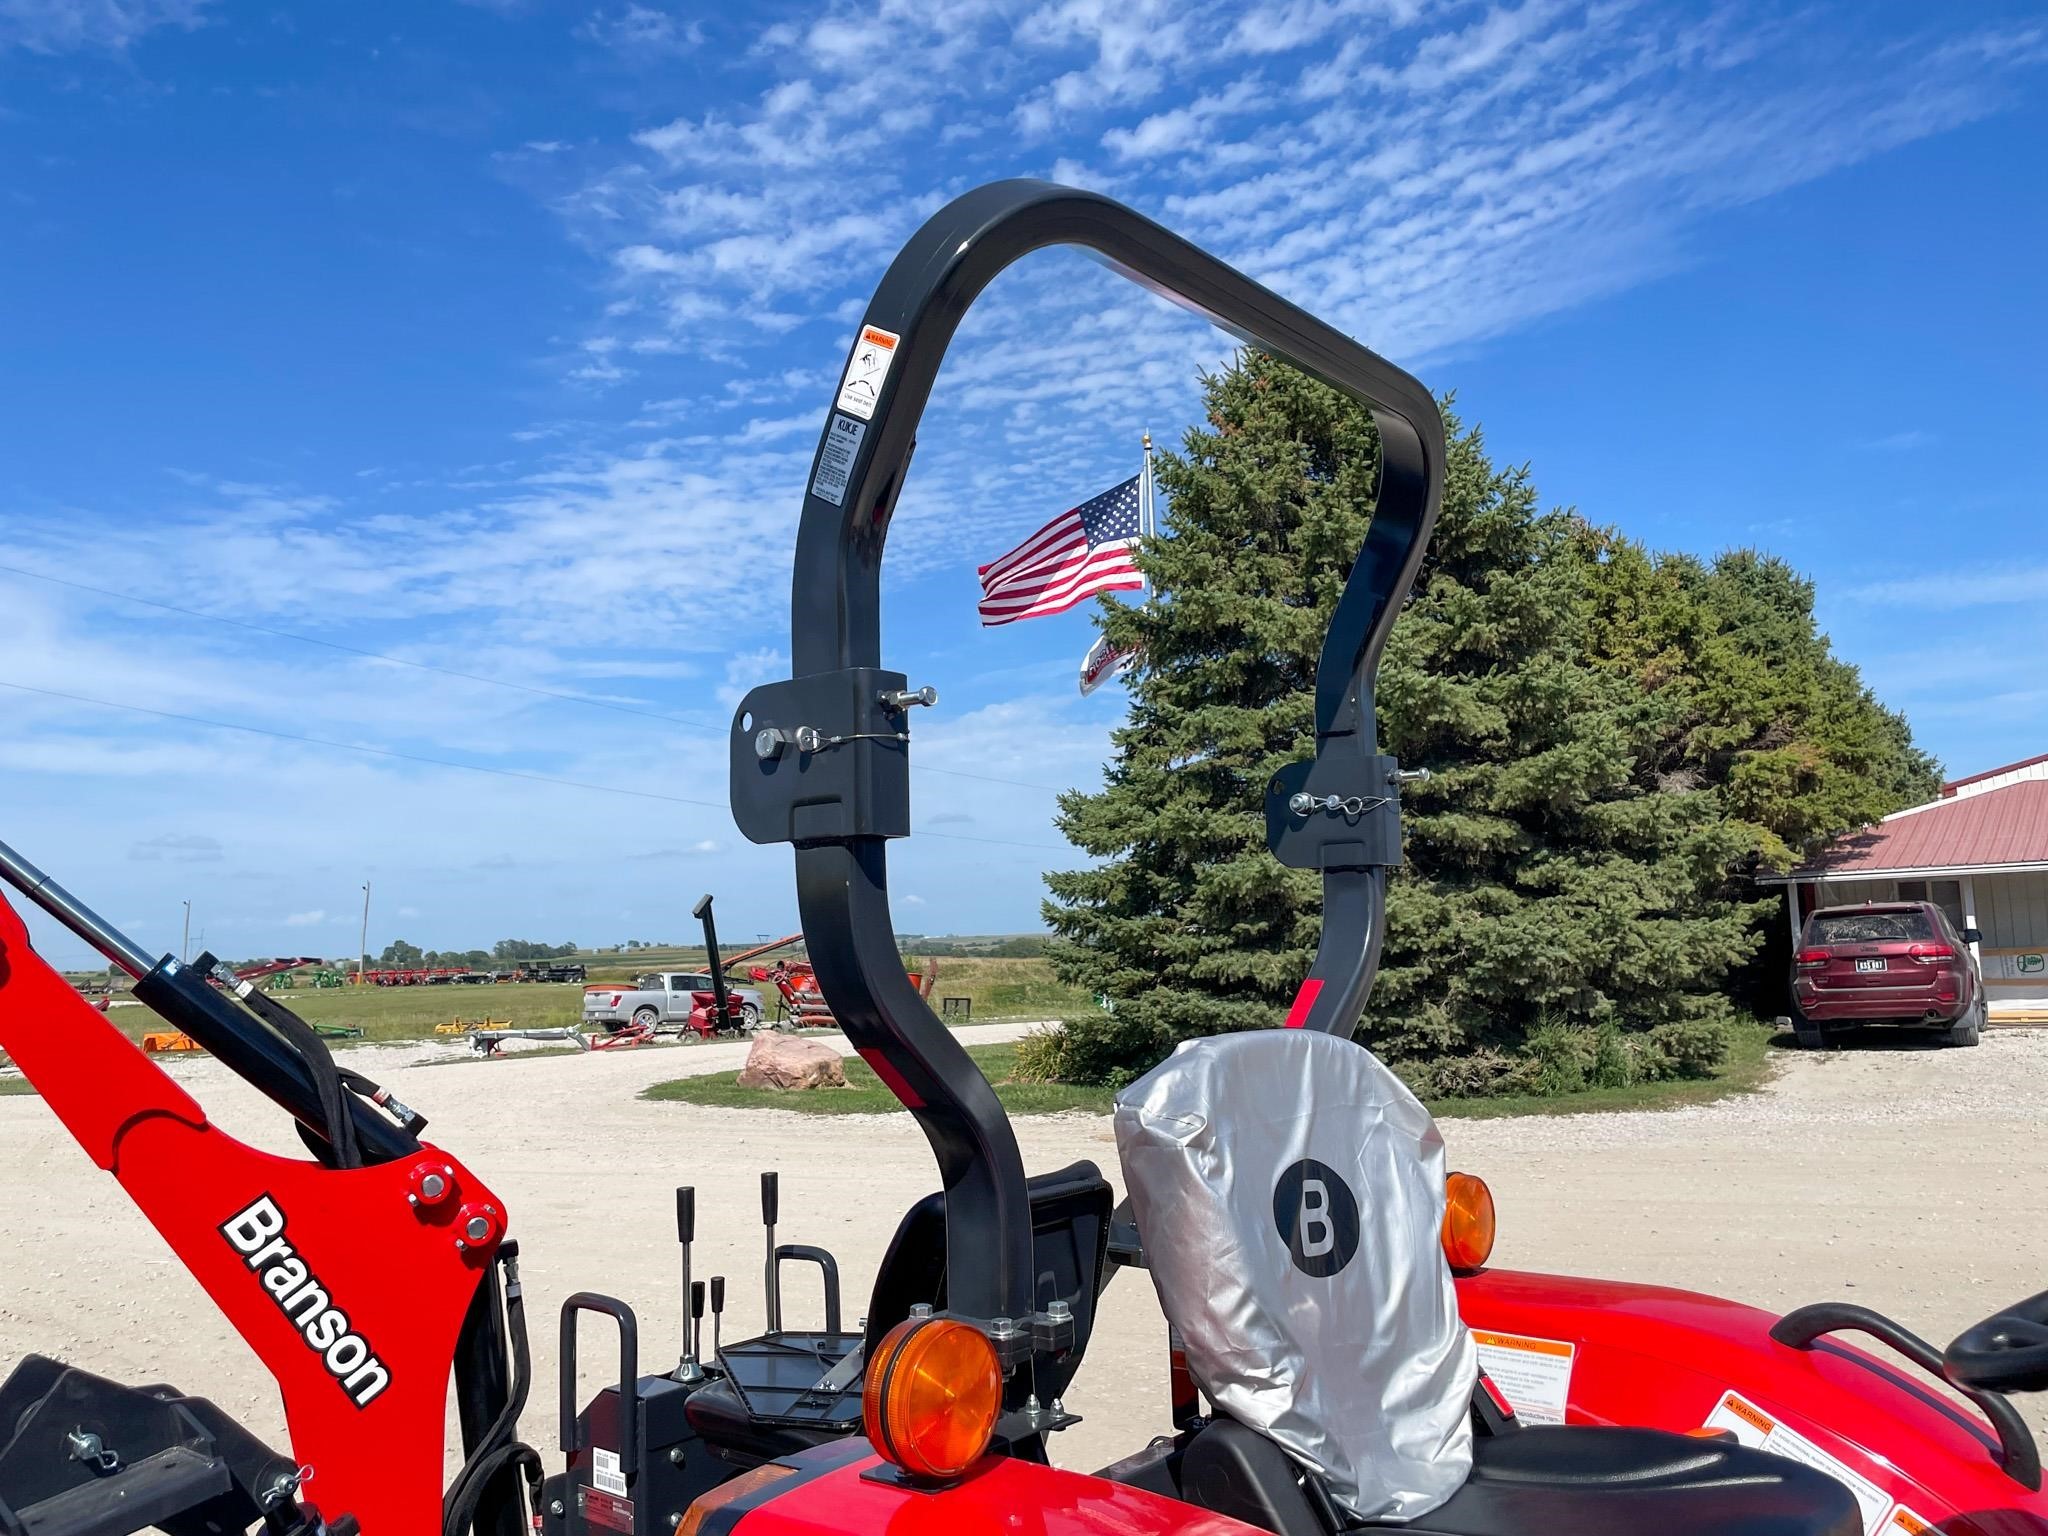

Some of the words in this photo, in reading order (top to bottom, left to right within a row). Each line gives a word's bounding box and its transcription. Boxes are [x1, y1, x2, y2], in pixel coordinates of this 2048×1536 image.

[838, 419, 859, 435] KUKJE
[1300, 1179, 1334, 1258] B
[219, 1192, 391, 1409] Branson
[1497, 1339, 1537, 1350] WARNING
[1735, 1403, 1772, 1431] WARNING
